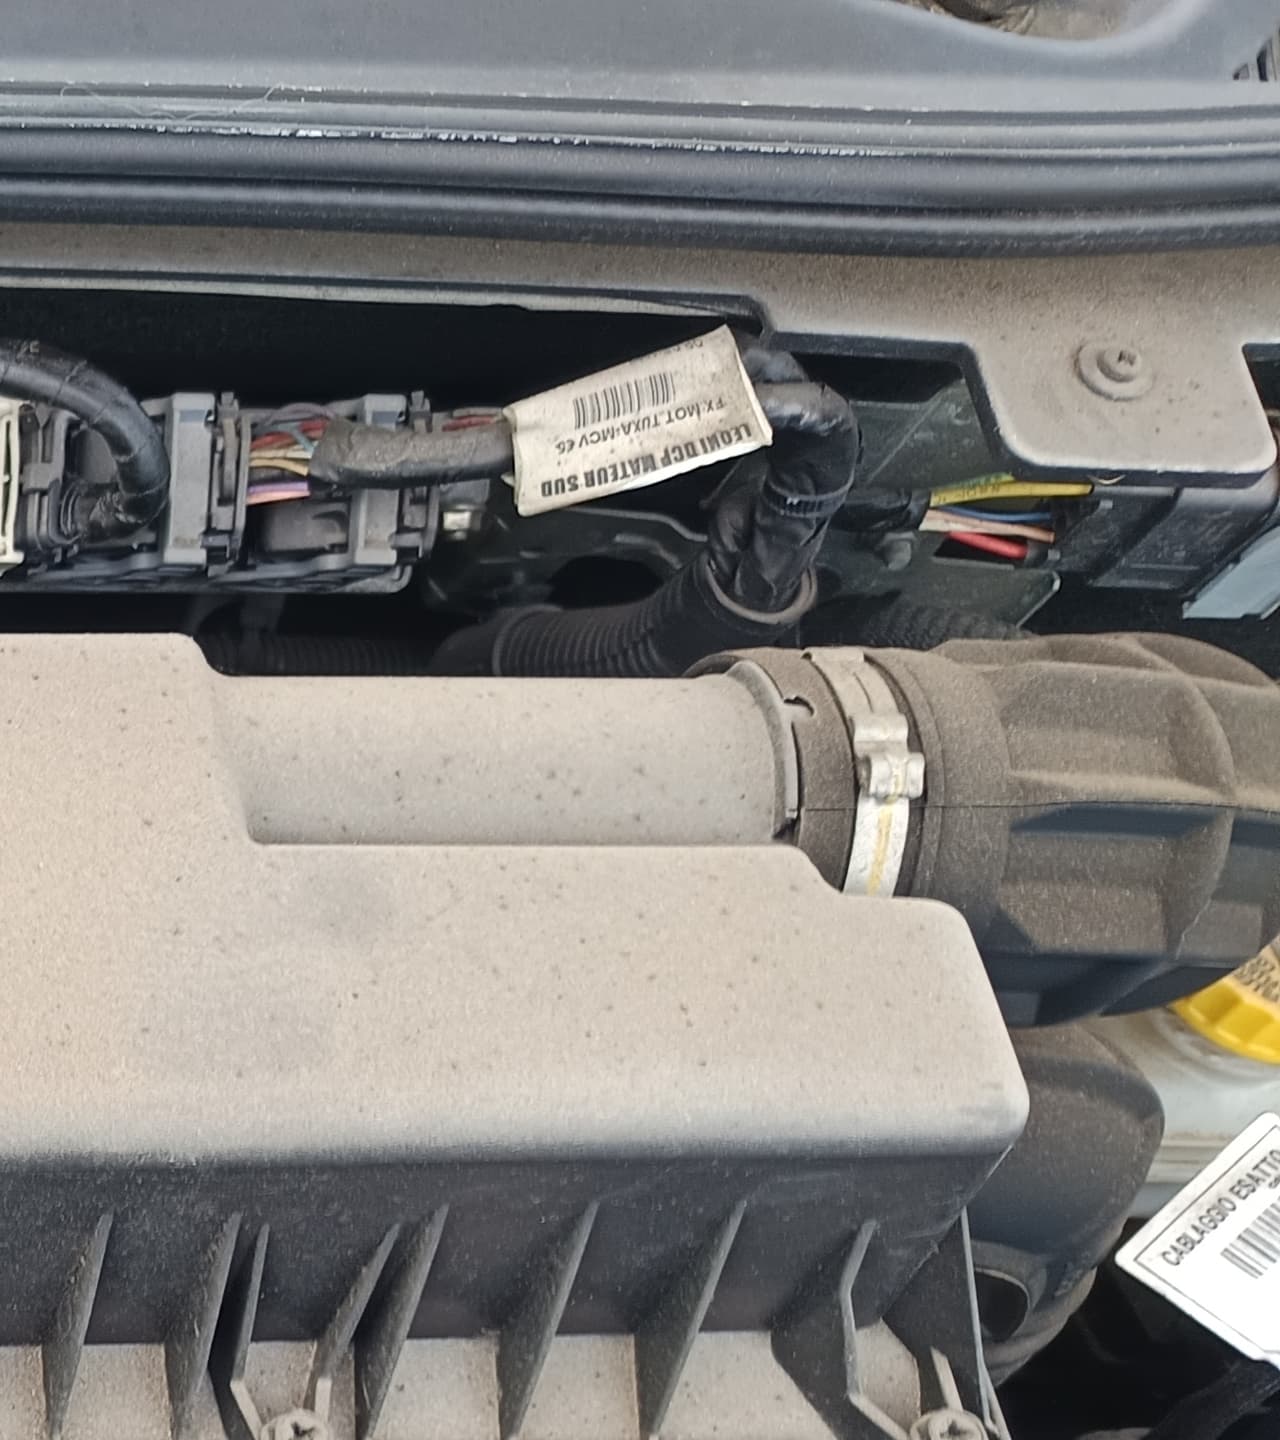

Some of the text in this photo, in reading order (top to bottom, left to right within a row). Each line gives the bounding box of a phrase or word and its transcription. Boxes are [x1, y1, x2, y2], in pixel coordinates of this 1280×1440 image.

[541, 475, 578, 498] SUD
[584, 453, 657, 488] MATEUR
[1161, 1198, 1237, 1266] CABLAGGIO
